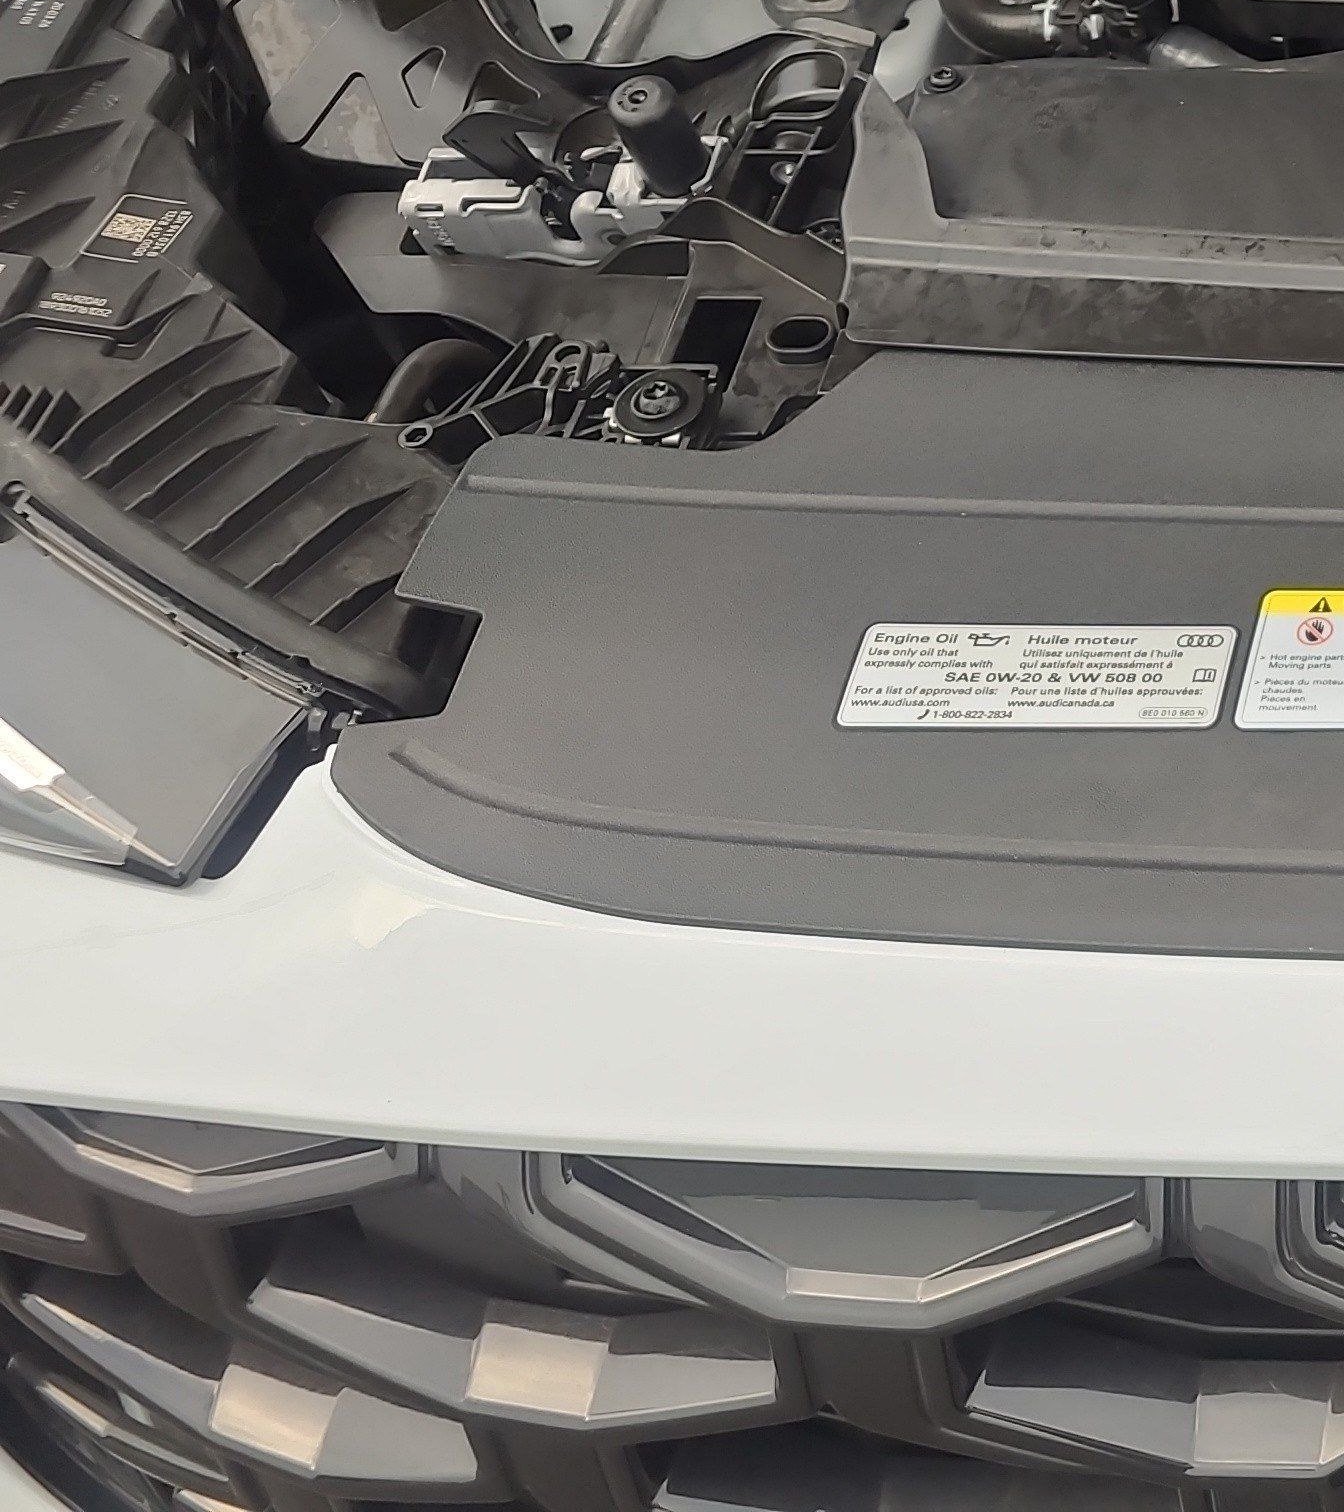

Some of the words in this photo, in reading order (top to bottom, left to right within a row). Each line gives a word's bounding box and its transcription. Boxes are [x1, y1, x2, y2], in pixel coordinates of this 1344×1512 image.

[873, 633, 930, 645] Engine
[936, 633, 958, 644] Oil
[1028, 634, 1069, 645] Huile
[1075, 635, 1138, 645] moteur
[868, 648, 890, 656] Use
[893, 648, 917, 658] only
[920, 648, 934, 656] oil
[937, 648, 959, 656] that
[1022, 649, 1062, 658] Utilisez
[1066, 650, 1131, 660] uniquement
[1134, 649, 1148, 658] de
[1290, 654, 1322, 662] engine
[864, 659, 916, 669] expressly
[918, 659, 966, 669] complies
[970, 659, 993, 668] with
[1019, 660, 1038, 670] qui
[1040, 660, 1084, 669] satisfait
[1086, 660, 1164, 671] expressément
[1268, 662, 1305, 670] Moving
[944, 672, 982, 683] SAE
[986, 672, 1042, 683] 0W-20
[1048, 672, 1062, 683] &
[1069, 672, 1101, 683] VW
[1105, 672, 1137, 683] 508
[1141, 672, 1163, 683] 00
[854, 686, 874, 695] For
[886, 686, 904, 695] list
[907, 686, 919, 695] of
[919, 686, 973, 697] approved
[975, 686, 998, 695] oils:
[1011, 686, 1037, 696] Pour
[1040, 688, 1061, 696] une
[1064, 686, 1087, 696] liste
[1136, 686, 1203, 698] approuvées:
[851, 698, 949, 707] www.audiusa.com
[1007, 699, 1115, 708] www.audicanada.ca
[933, 710, 1012, 719] 1-800-822-2834
